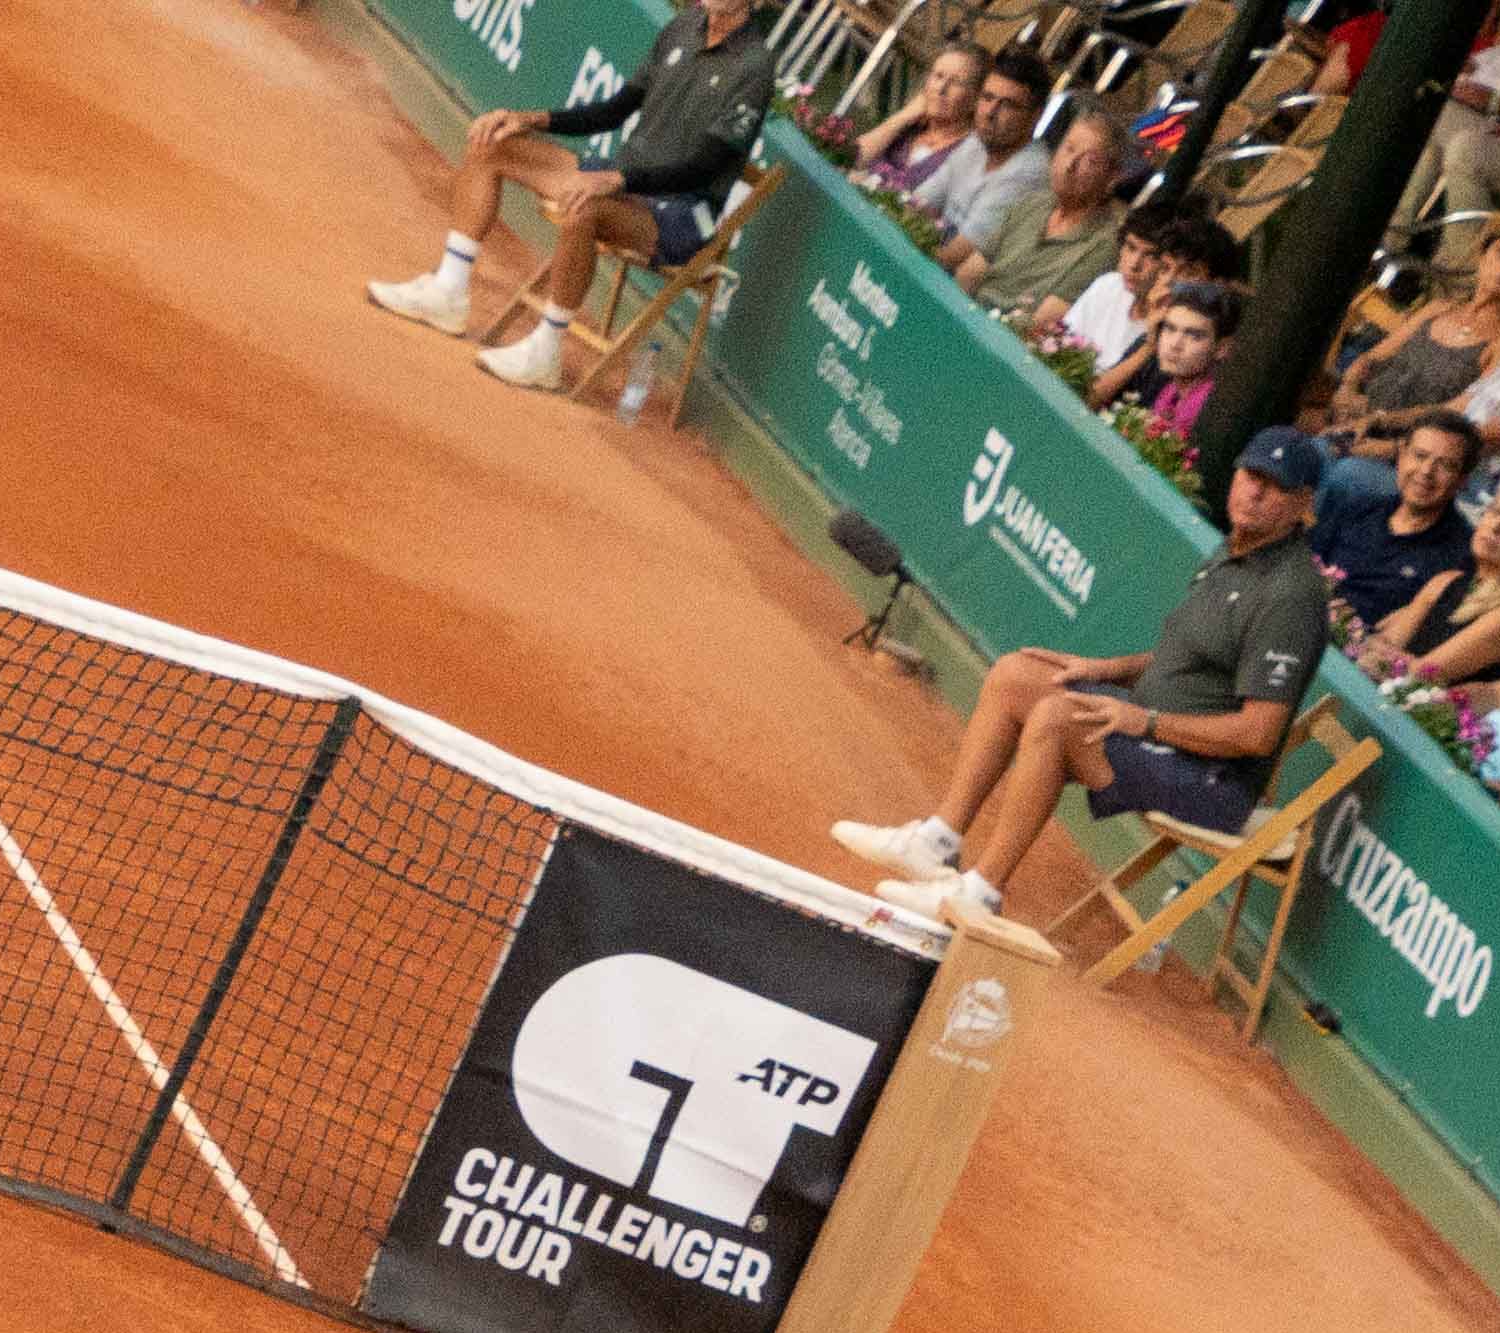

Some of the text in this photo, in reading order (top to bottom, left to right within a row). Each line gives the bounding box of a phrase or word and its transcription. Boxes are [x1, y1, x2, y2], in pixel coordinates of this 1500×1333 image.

[1319, 795, 1492, 1018] Cruzcampo
[736, 1057, 841, 1108] ATP
[437, 1196, 573, 1287] TOUR
[453, 1146, 772, 1303] CHALLENGER
